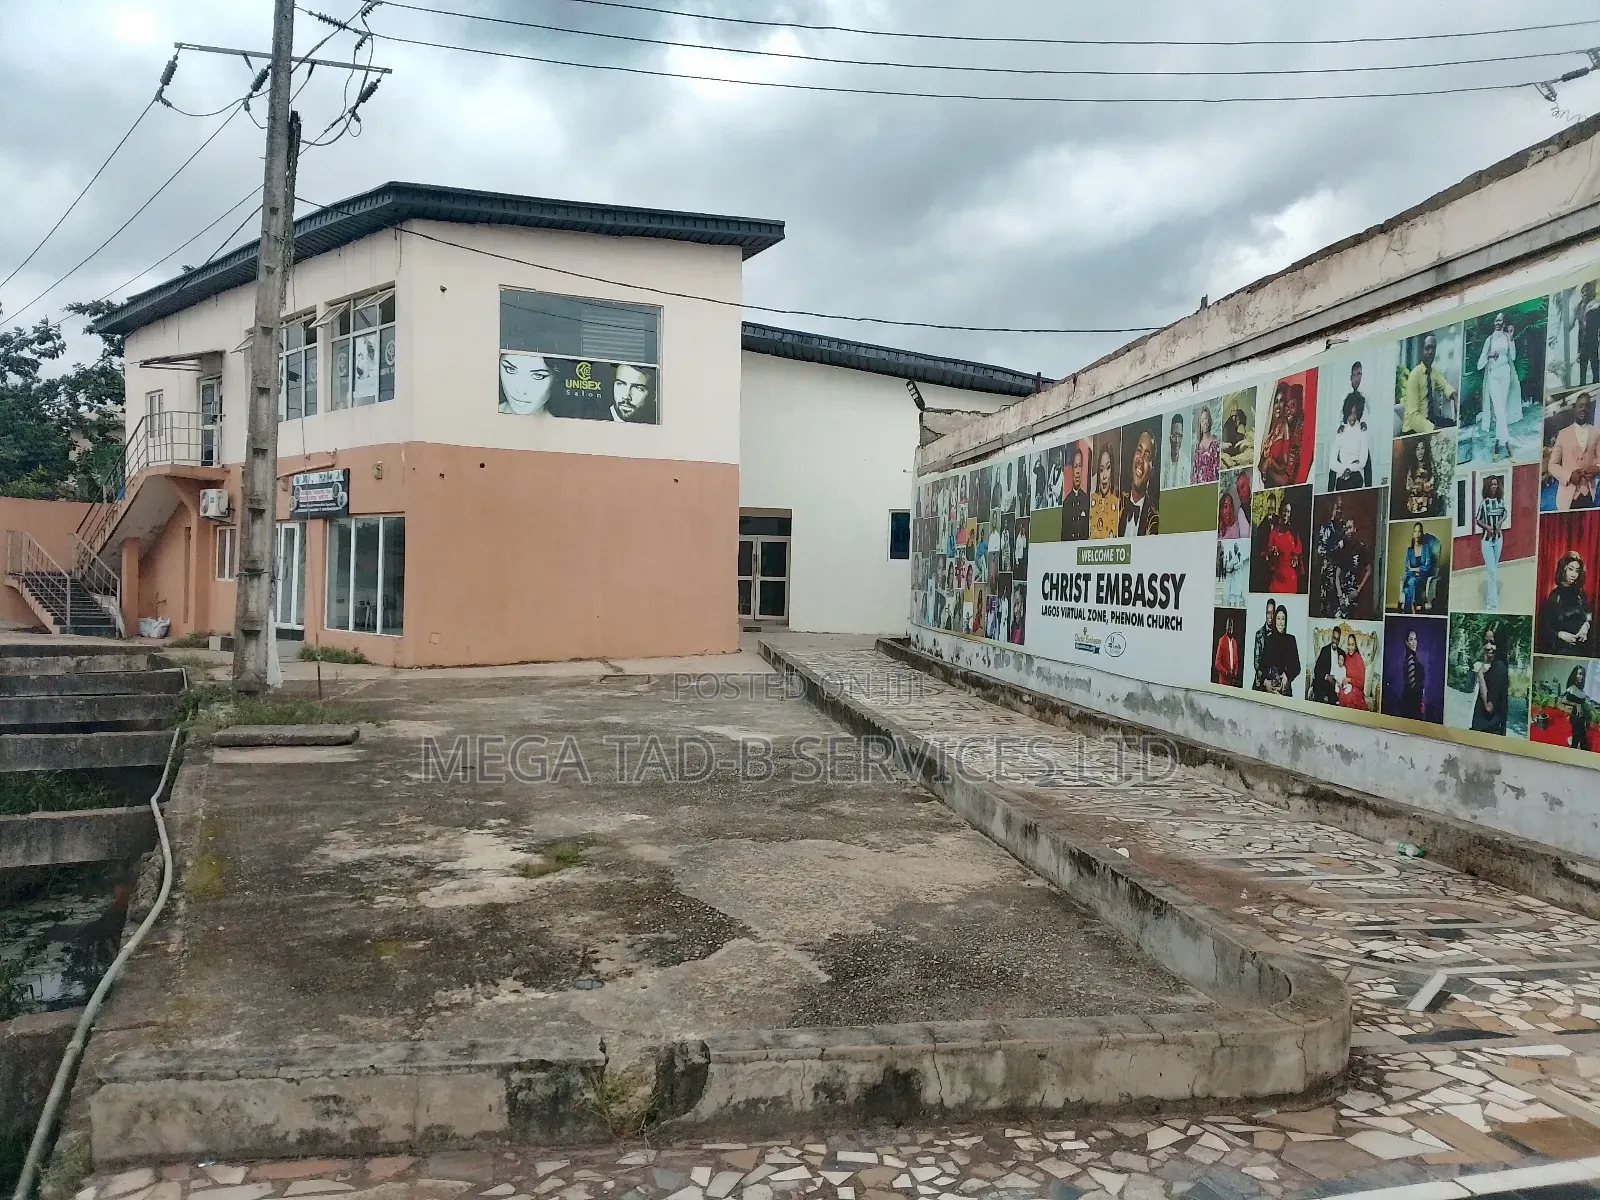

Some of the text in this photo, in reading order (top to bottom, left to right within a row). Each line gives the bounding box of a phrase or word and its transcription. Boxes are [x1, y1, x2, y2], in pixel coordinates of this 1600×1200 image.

[565, 379, 602, 390] UNISEX
[566, 390, 602, 398] Salon
[1081, 548, 1126, 562] WELCOME TO
[1041, 572, 1186, 610] CHRIST EMBASSY
[1041, 605, 1183, 631] LAGOS VIRTUAL ZONE, PHENOM CHURCH
